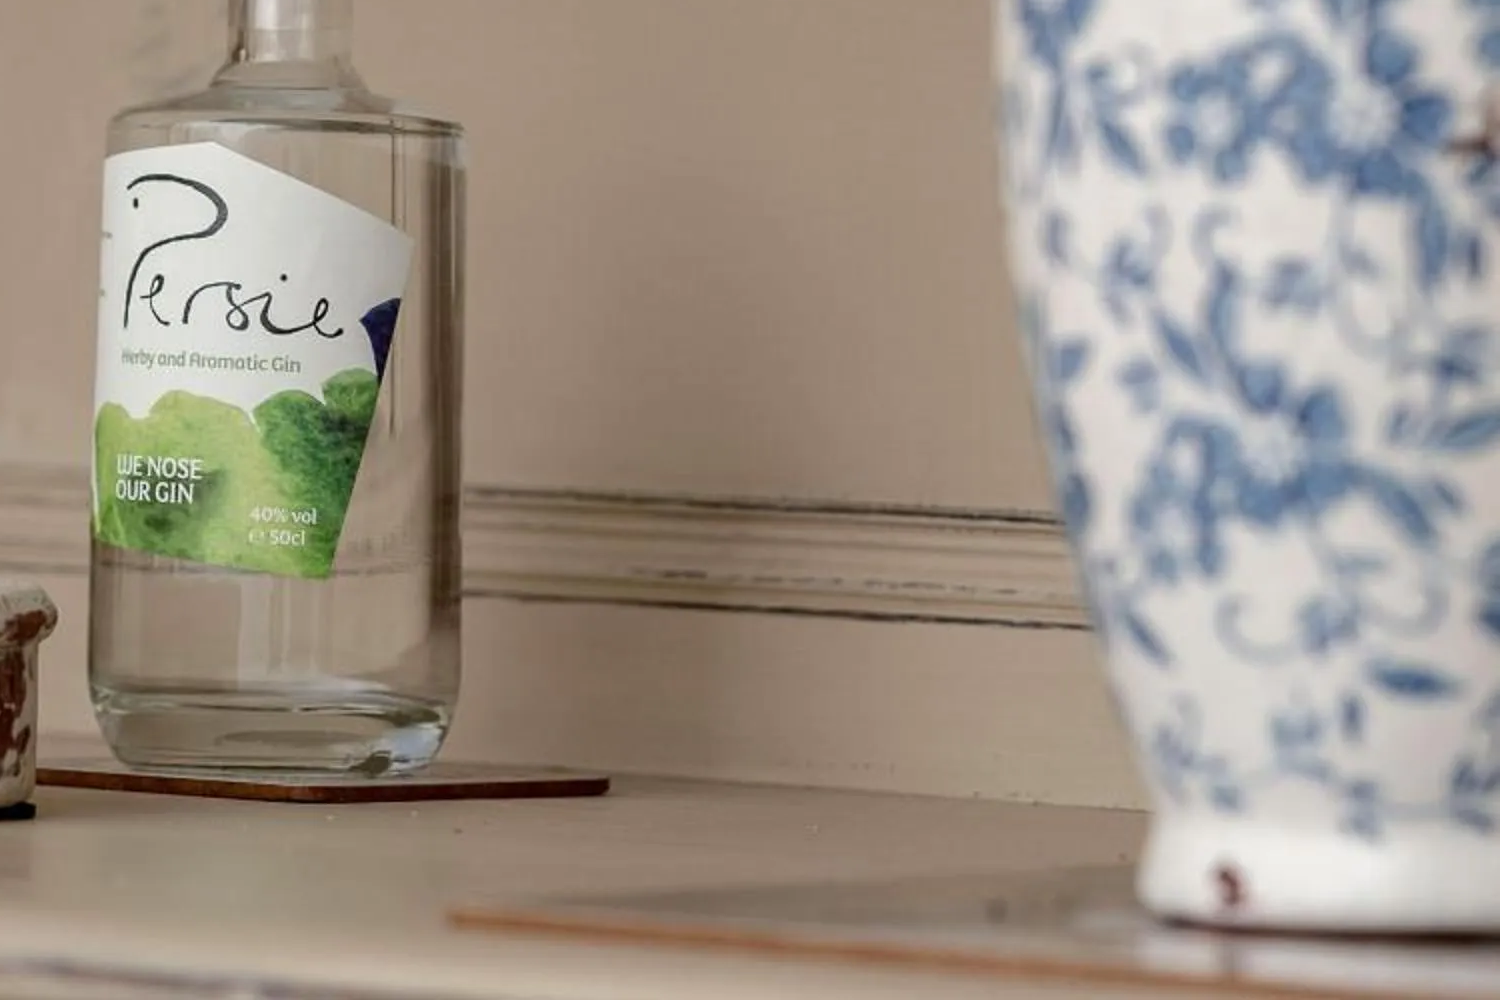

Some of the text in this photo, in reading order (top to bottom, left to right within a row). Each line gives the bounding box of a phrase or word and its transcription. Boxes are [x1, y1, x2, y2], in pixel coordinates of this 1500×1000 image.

[124, 173, 344, 338] Persie
[121, 347, 302, 374] Herby and Aromatic Gin
[116, 453, 204, 480] WE NOSE
[115, 478, 195, 505] OUR GIN
[248, 505, 317, 525] 40% vol
[269, 528, 306, 546] 50cl
